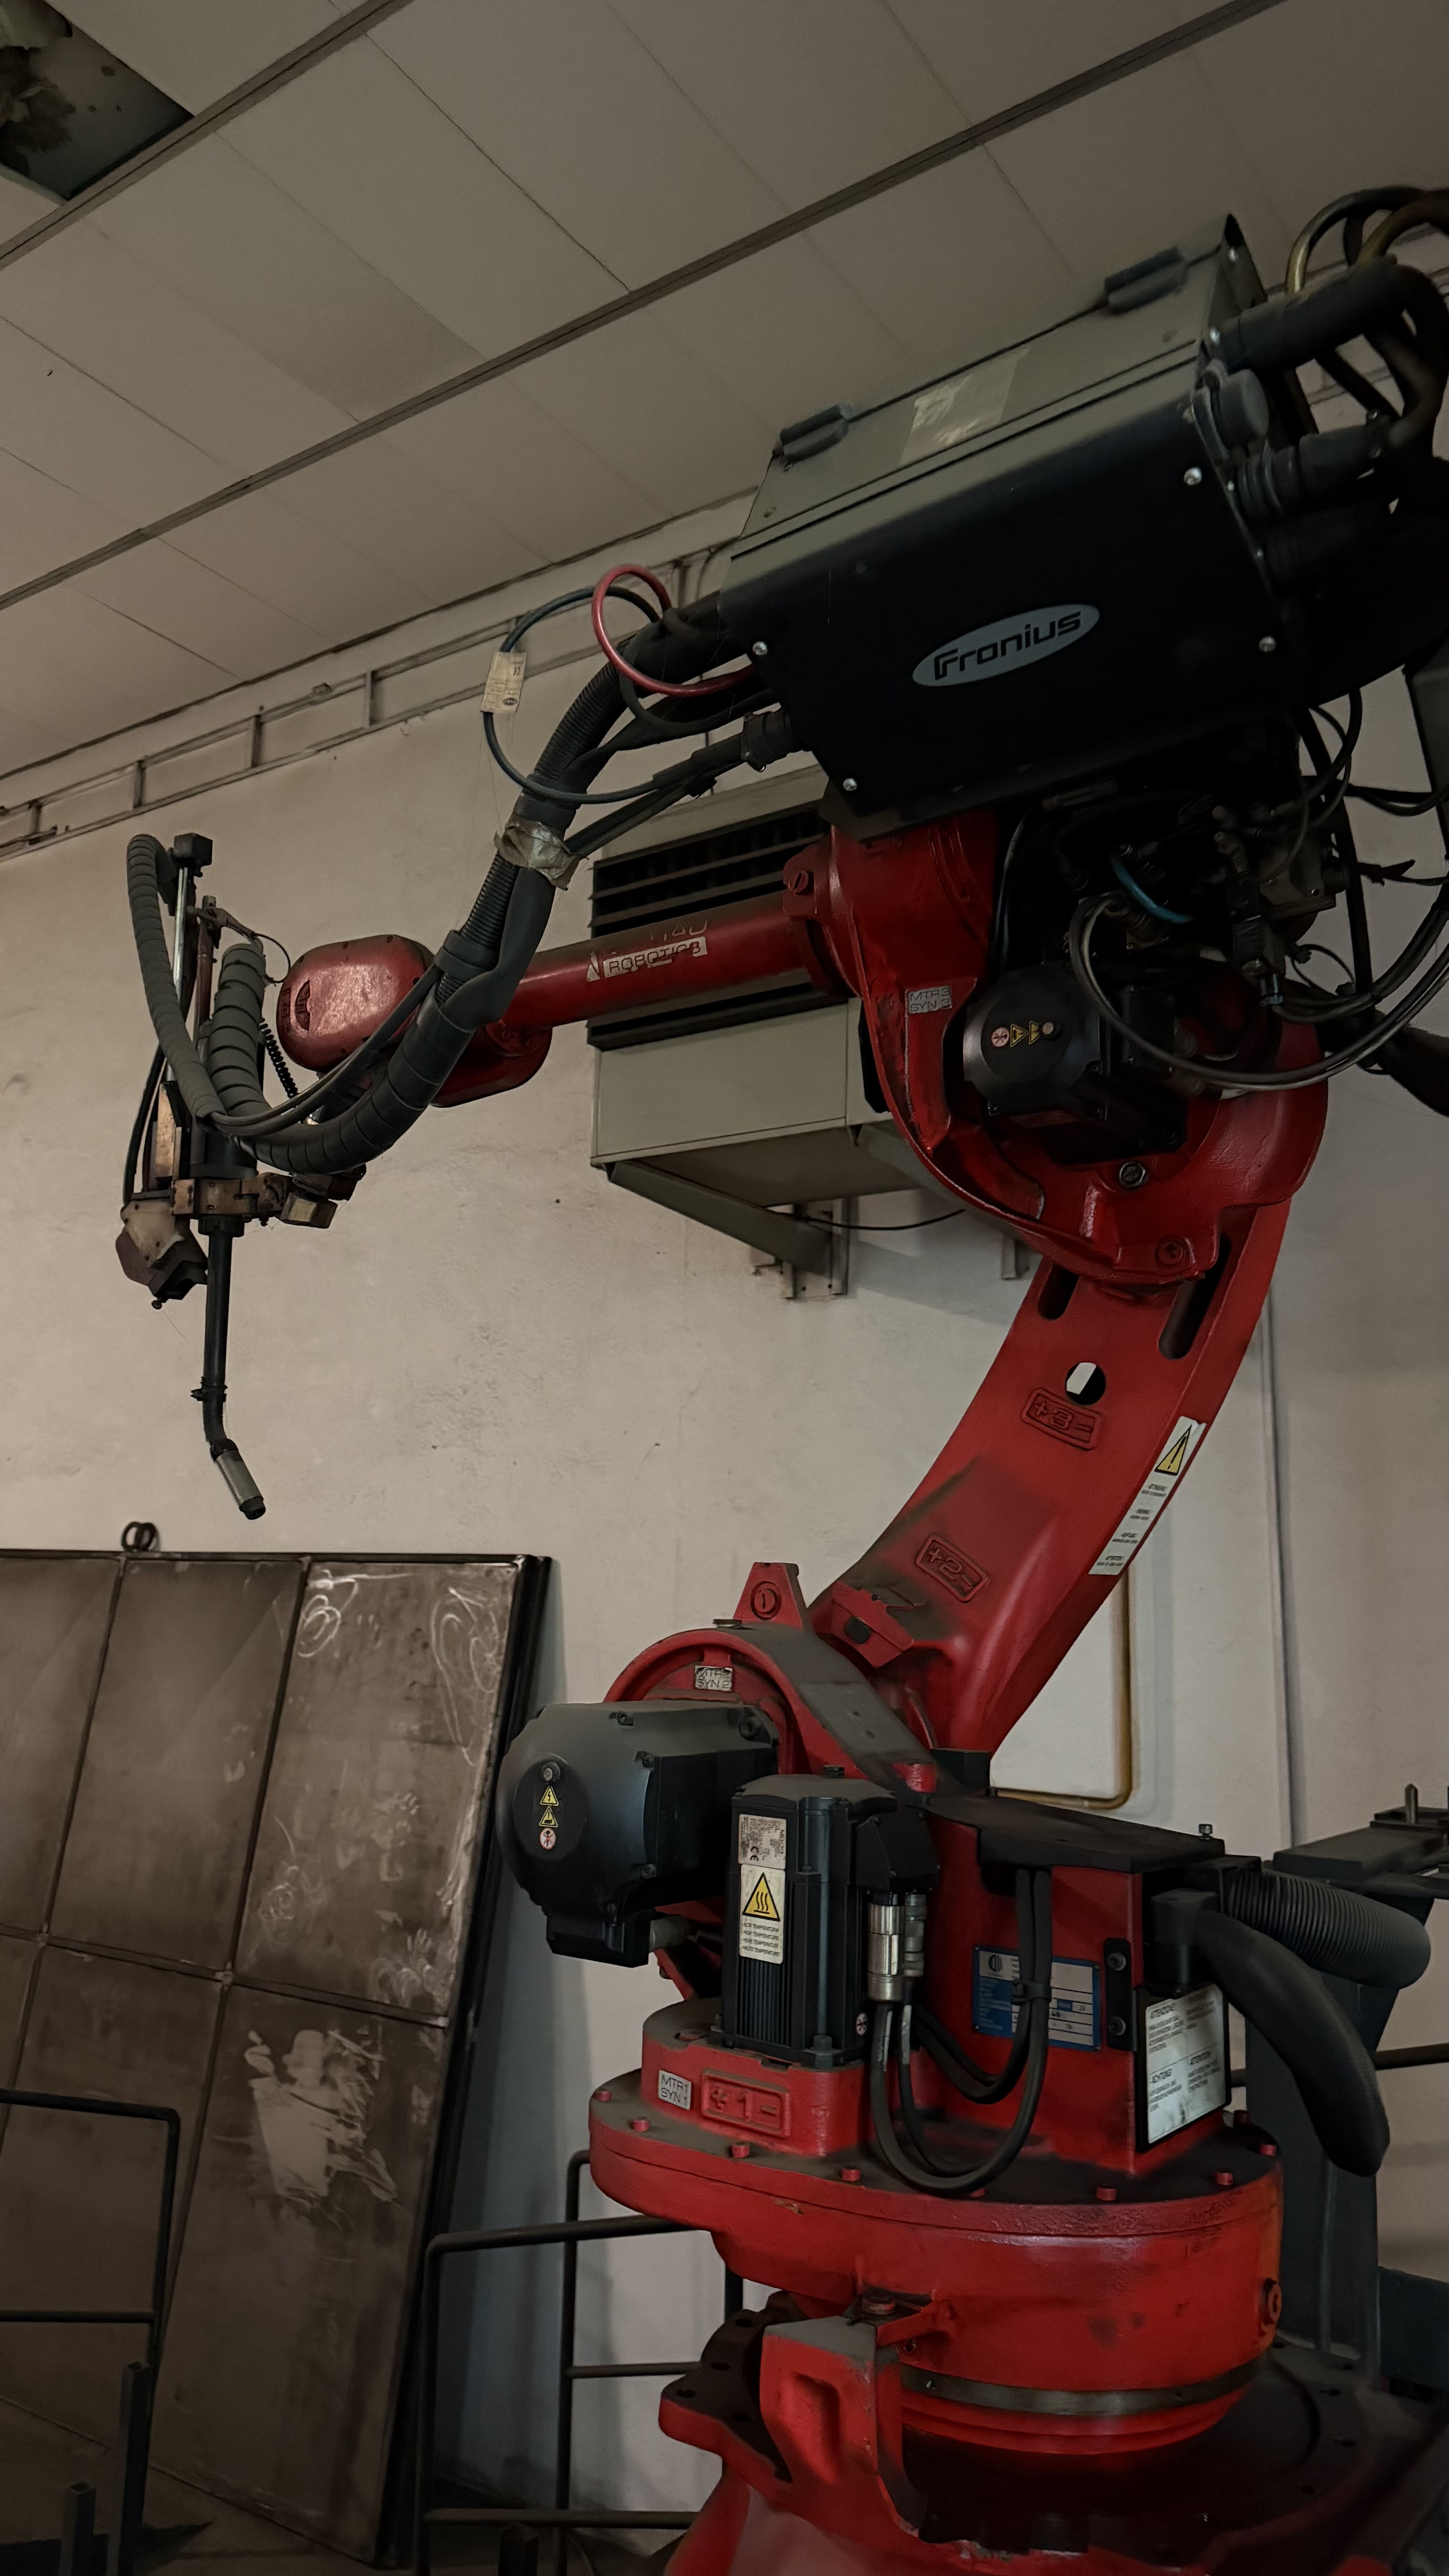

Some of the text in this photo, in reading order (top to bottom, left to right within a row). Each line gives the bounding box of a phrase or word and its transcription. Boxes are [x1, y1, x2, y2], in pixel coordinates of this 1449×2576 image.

[934, 611, 1081, 681] Fronius
[911, 999, 937, 1012] SYN
[697, 1679, 730, 1689] SYN 2
[661, 2088, 681, 2102] SYN
